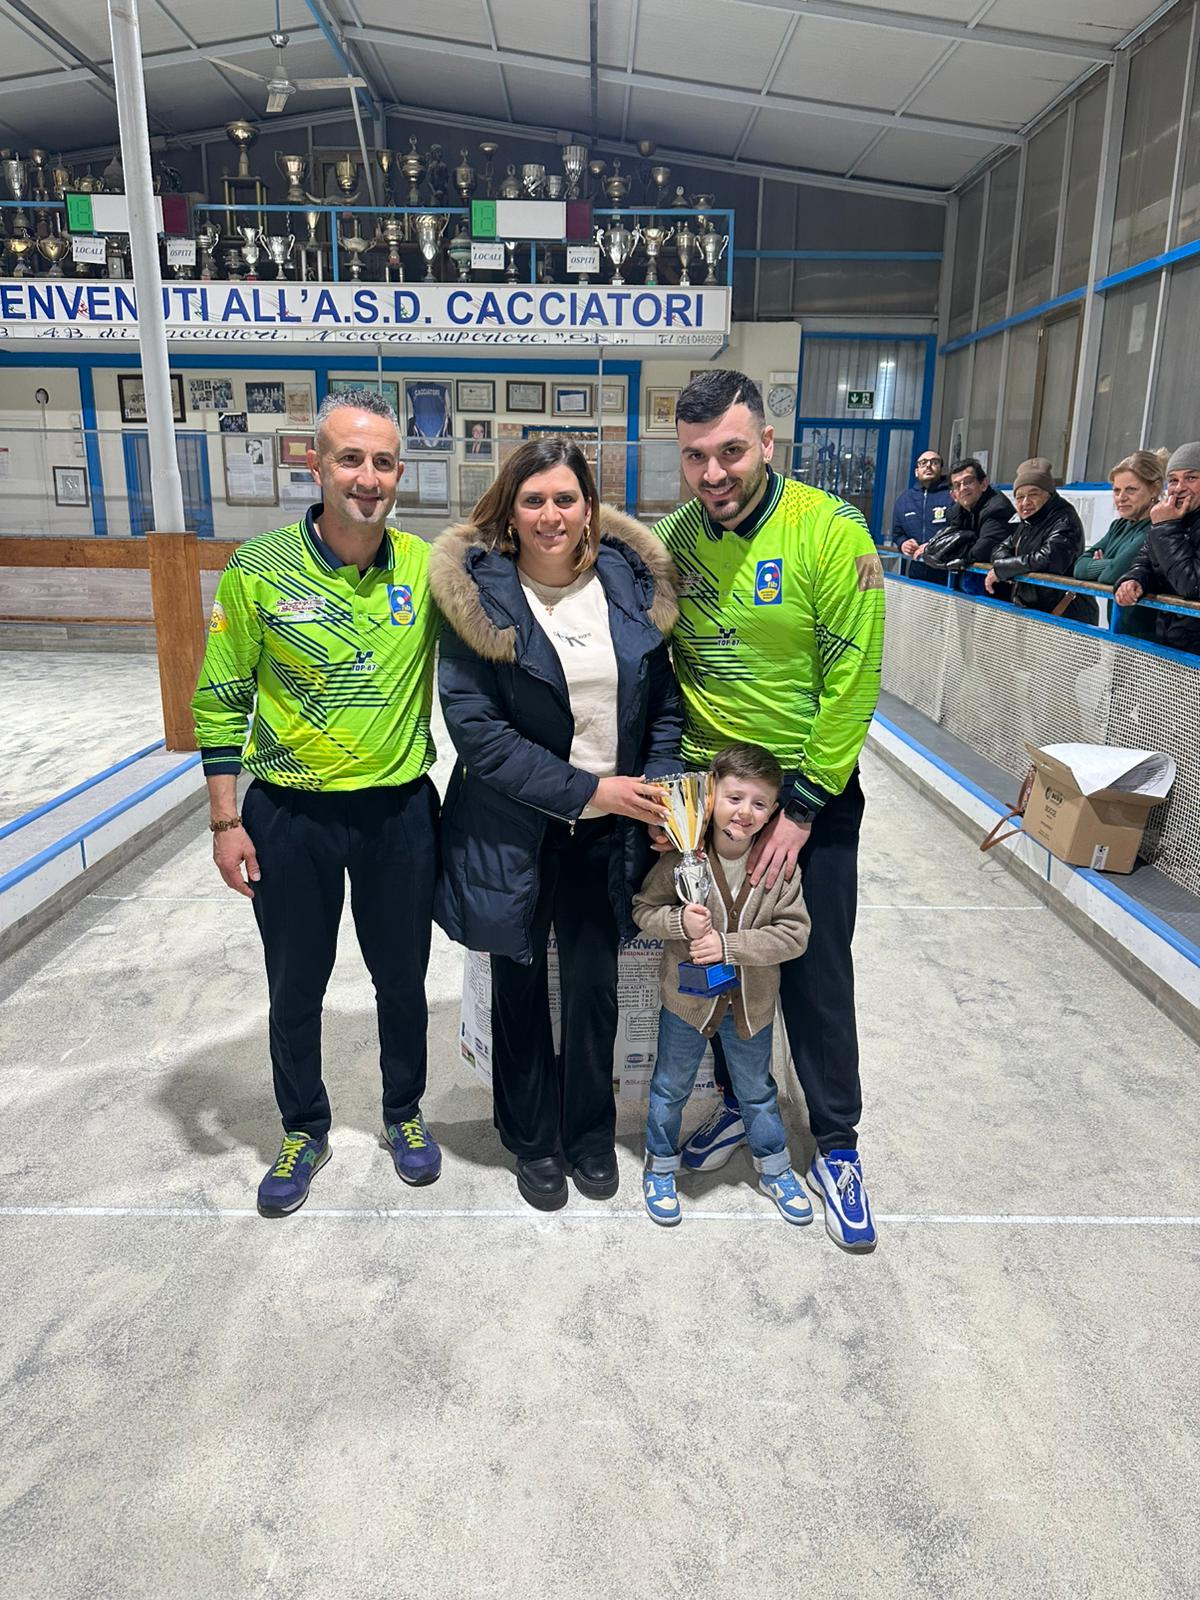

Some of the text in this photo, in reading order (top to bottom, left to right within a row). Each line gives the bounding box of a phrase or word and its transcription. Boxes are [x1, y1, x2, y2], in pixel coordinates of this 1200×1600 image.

[75, 246, 103, 256] LOCALI
[169, 249, 192, 258] OSPITI
[473, 252, 502, 261] LOCALI
[570, 256, 596, 264] OSPITI
[0, 285, 704, 327] ENVENTI ALL'A.S.D. CACCIATORI
